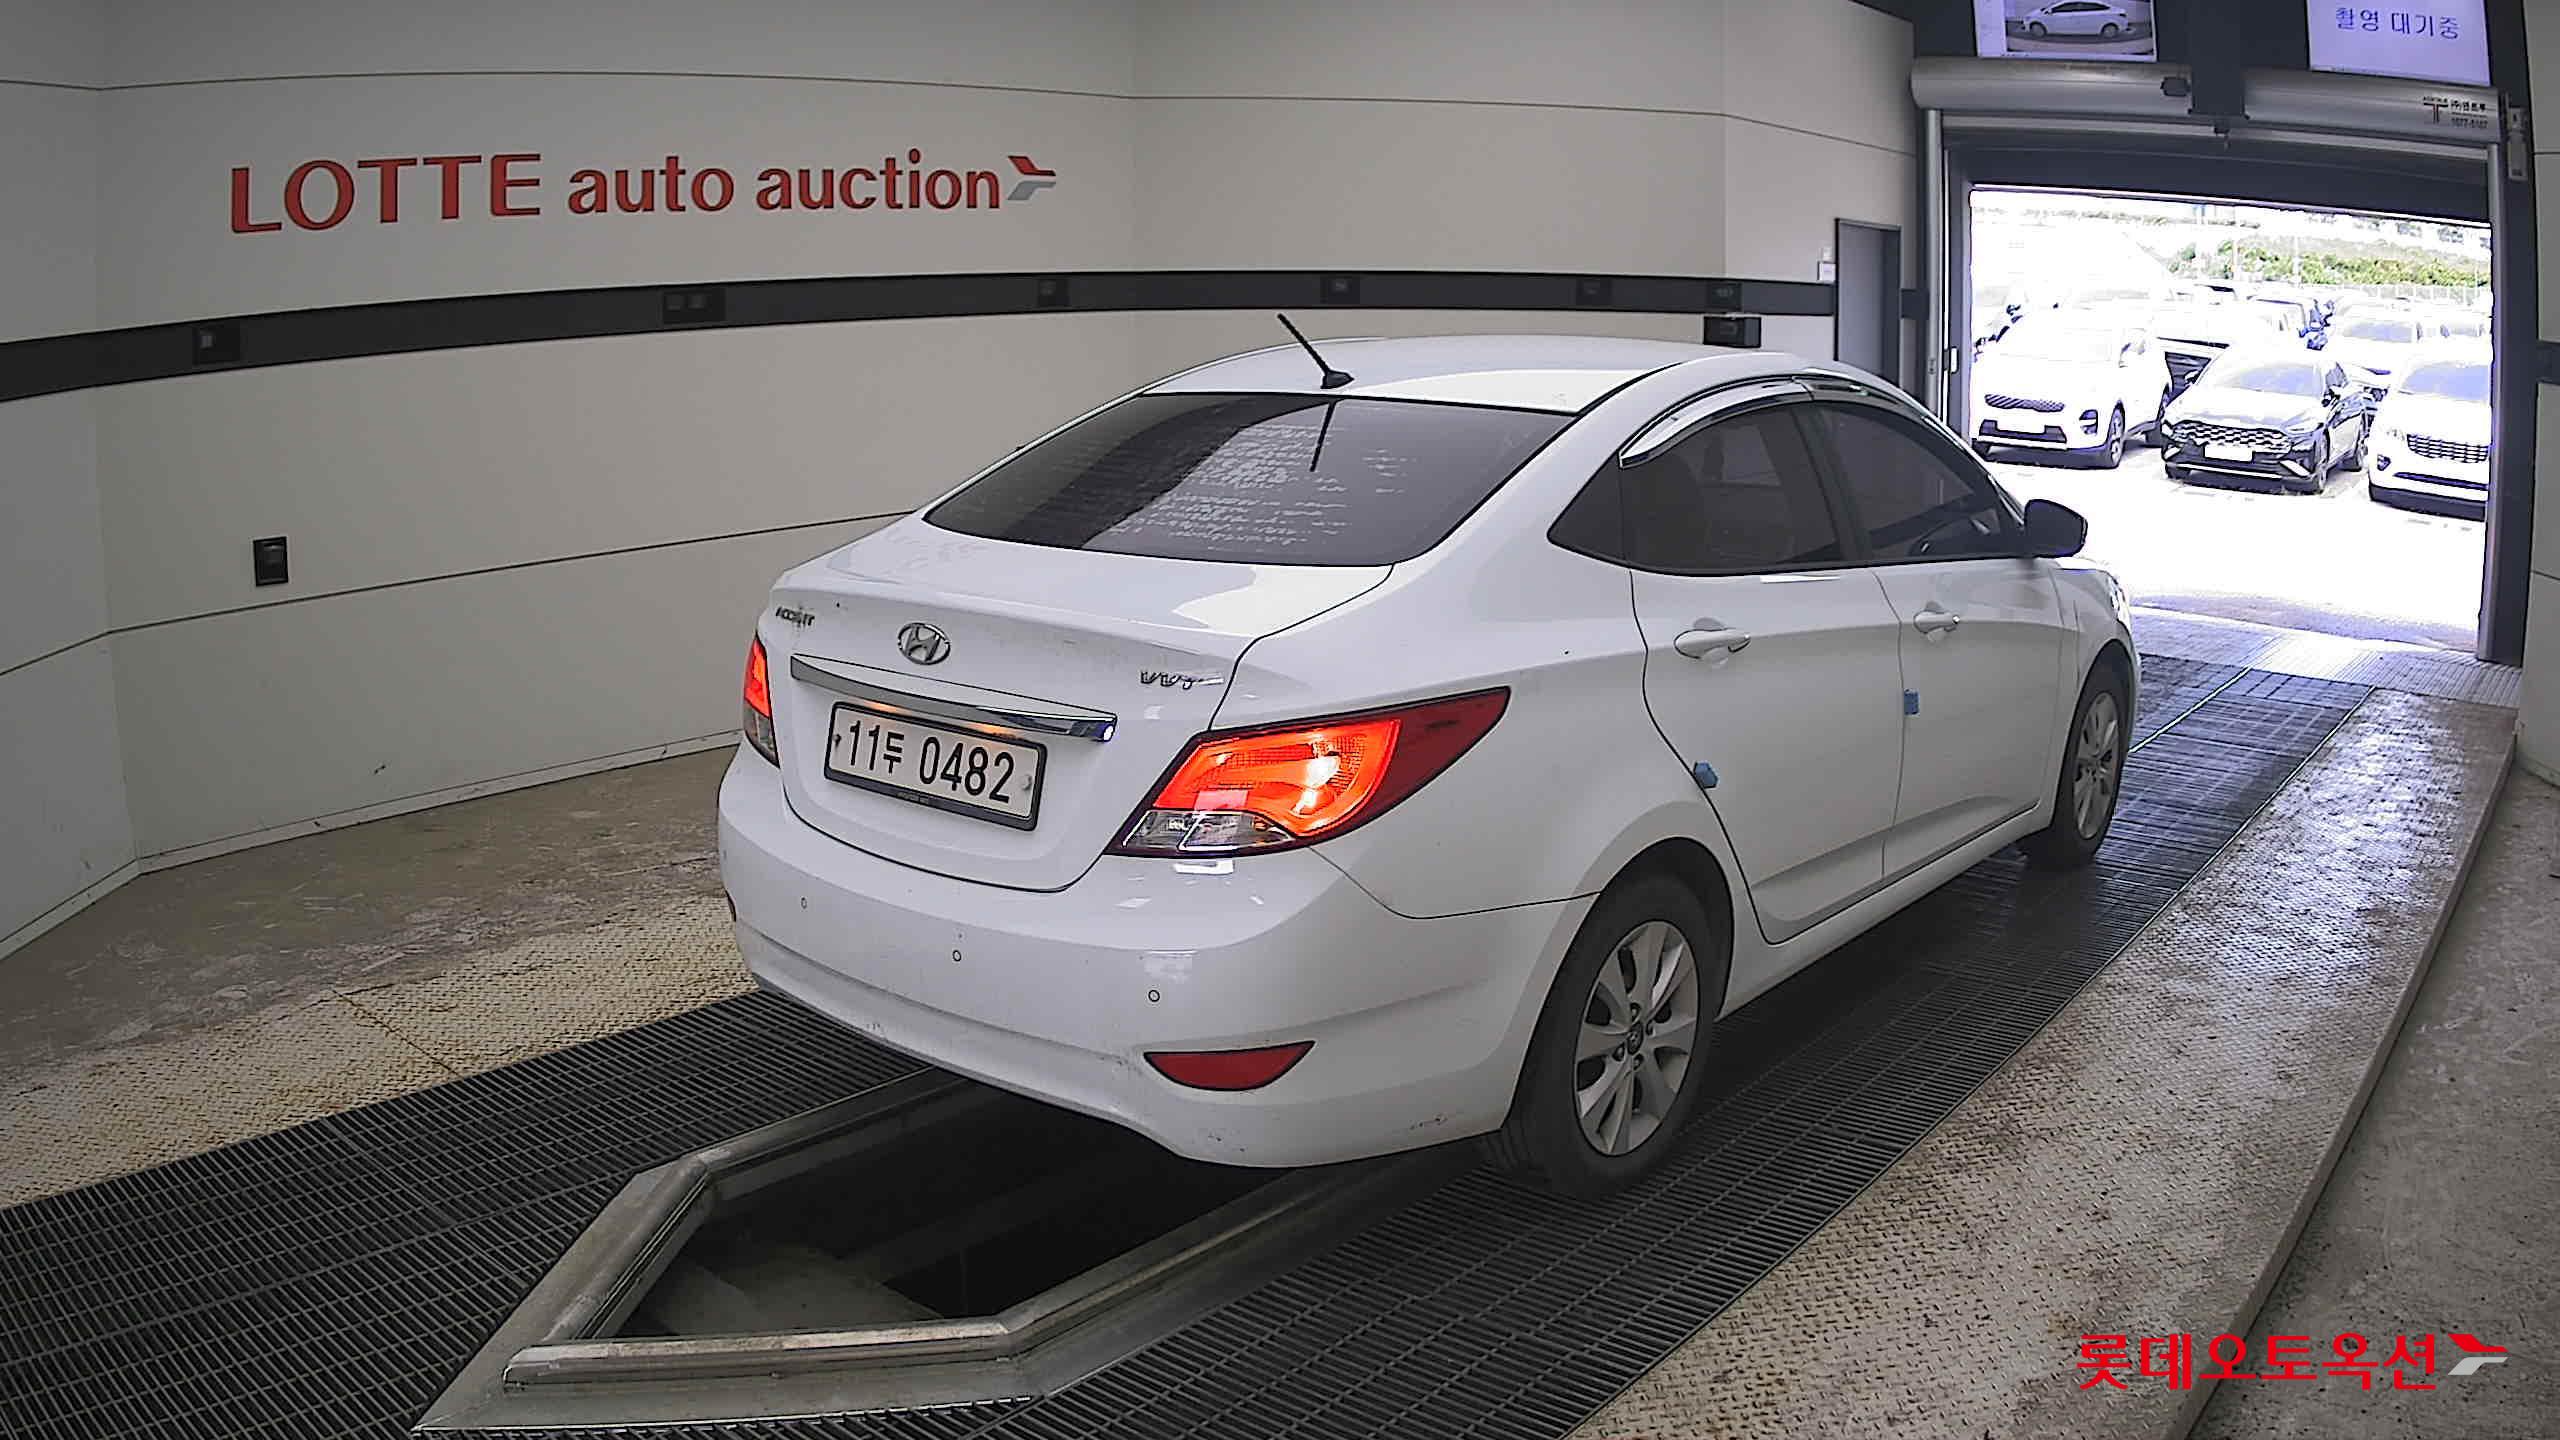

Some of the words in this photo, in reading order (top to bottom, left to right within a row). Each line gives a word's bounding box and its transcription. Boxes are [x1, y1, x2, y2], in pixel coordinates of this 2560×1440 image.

[2391, 12, 2459, 40] 대기중
[230, 153, 541, 234] LOTTE
[567, 155, 735, 214] auto
[755, 148, 1001, 211] auction
[849, 719, 905, 775] 11두
[918, 736, 1015, 804] 0482
